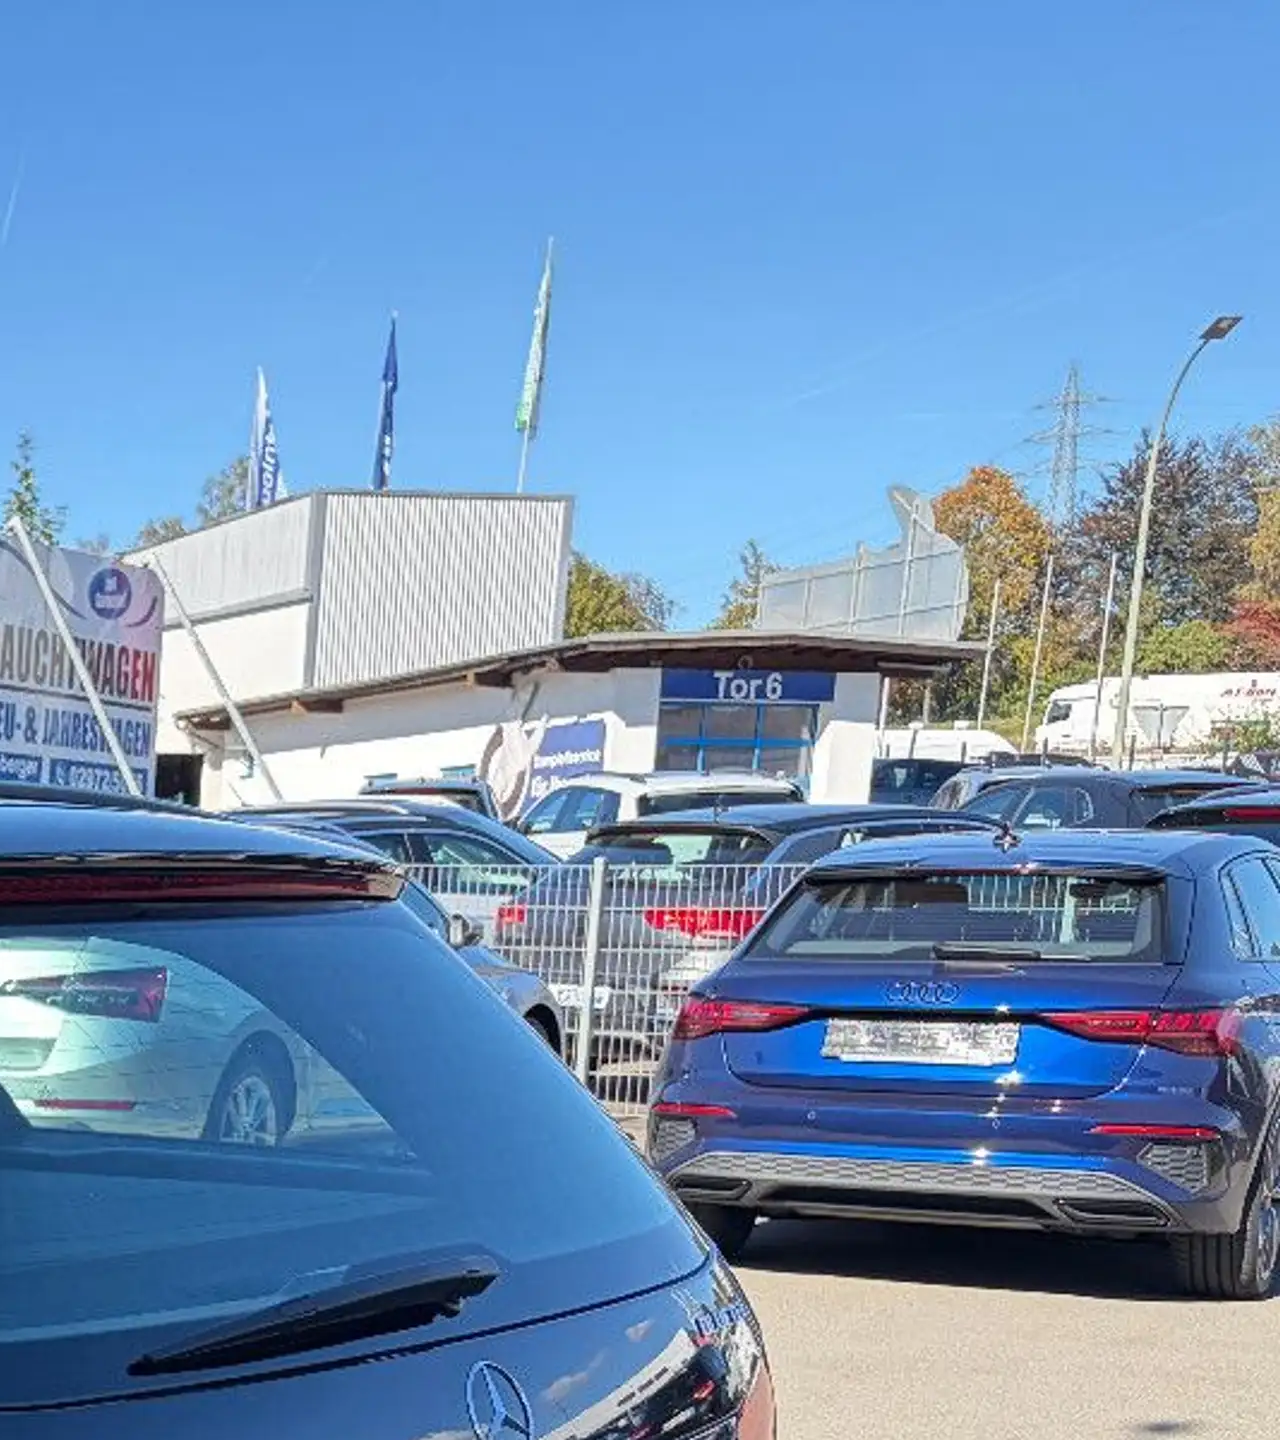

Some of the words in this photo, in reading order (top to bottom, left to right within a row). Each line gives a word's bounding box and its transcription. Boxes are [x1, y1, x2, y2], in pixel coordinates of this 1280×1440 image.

[713, 671, 763, 701] Tor
[766, 671, 783, 701] 6
[24, 706, 38, 744] &
